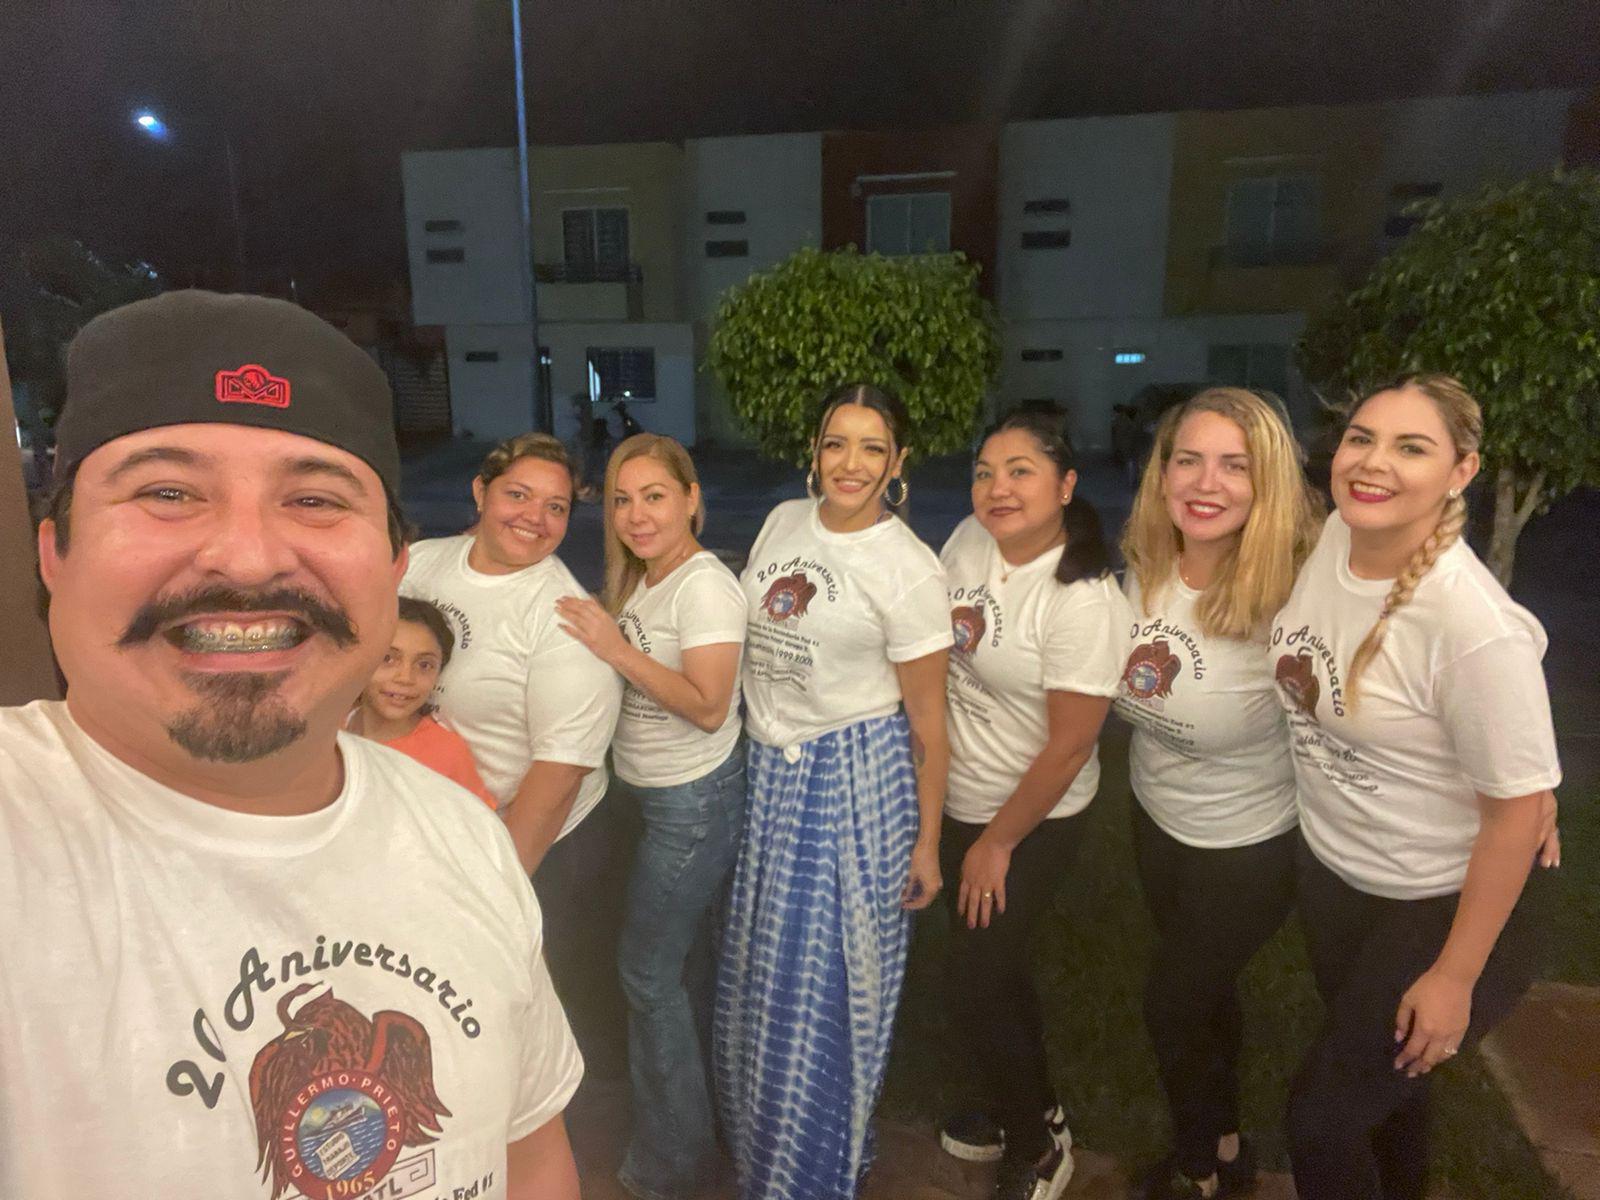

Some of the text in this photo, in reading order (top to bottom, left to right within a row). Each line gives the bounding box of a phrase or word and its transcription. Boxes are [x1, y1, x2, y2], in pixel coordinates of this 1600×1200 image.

[757, 556, 840, 602] 20 Aniversario
[1142, 618, 1207, 681] Aniversario
[1286, 625, 1345, 718] Aniversario
[166, 934, 481, 1109] 20 Aniversario
[282, 1073, 400, 1178] GUILLERMO PRIETO
[326, 1170, 376, 1200] 1965
